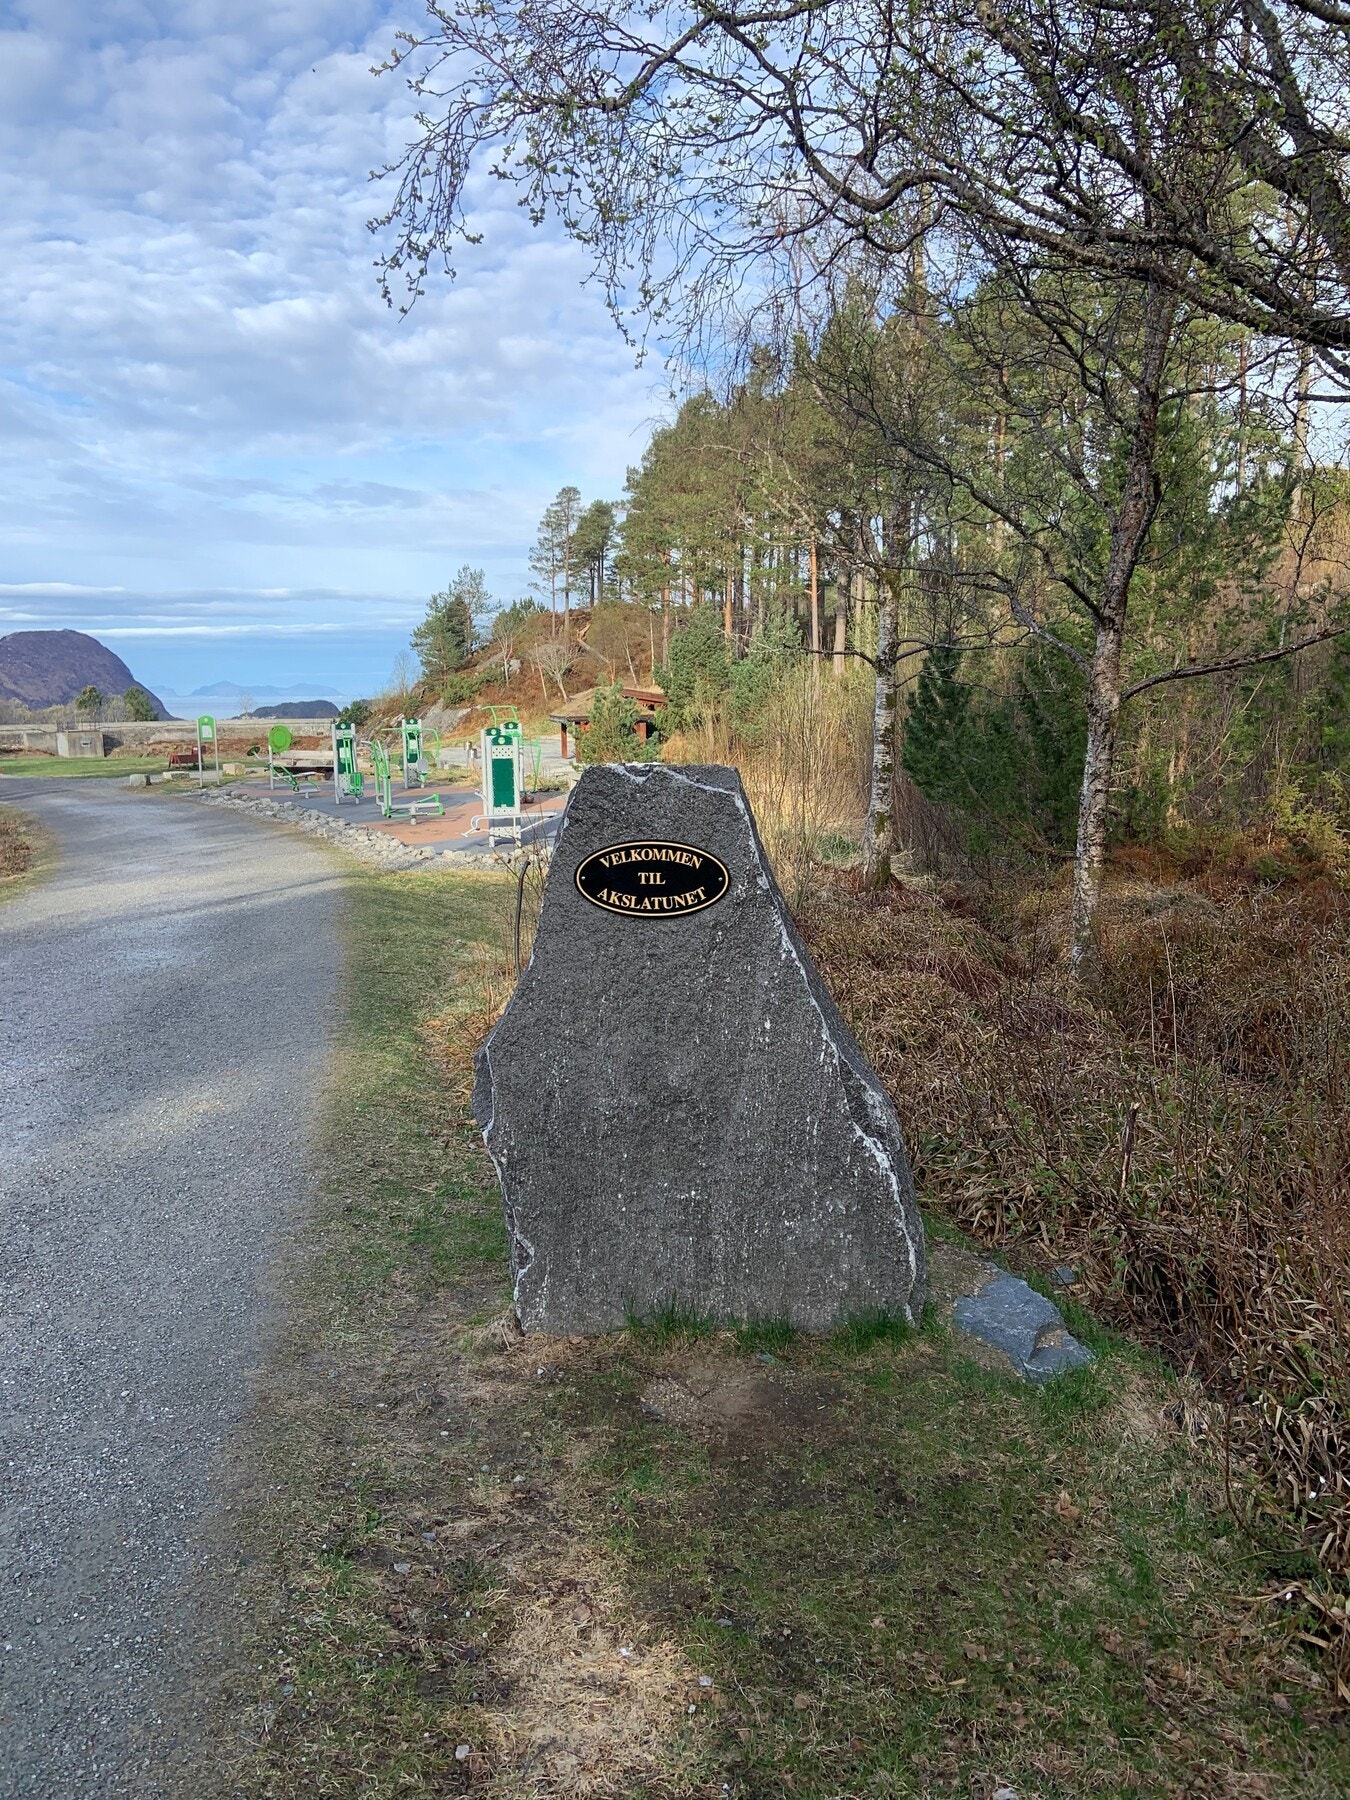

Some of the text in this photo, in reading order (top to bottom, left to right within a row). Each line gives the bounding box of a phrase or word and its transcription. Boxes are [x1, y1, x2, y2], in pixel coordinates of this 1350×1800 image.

[599, 848, 703, 869] VELKOMMEN
[638, 872, 666, 885] TIL
[597, 886, 707, 910] AKSLATUNET
